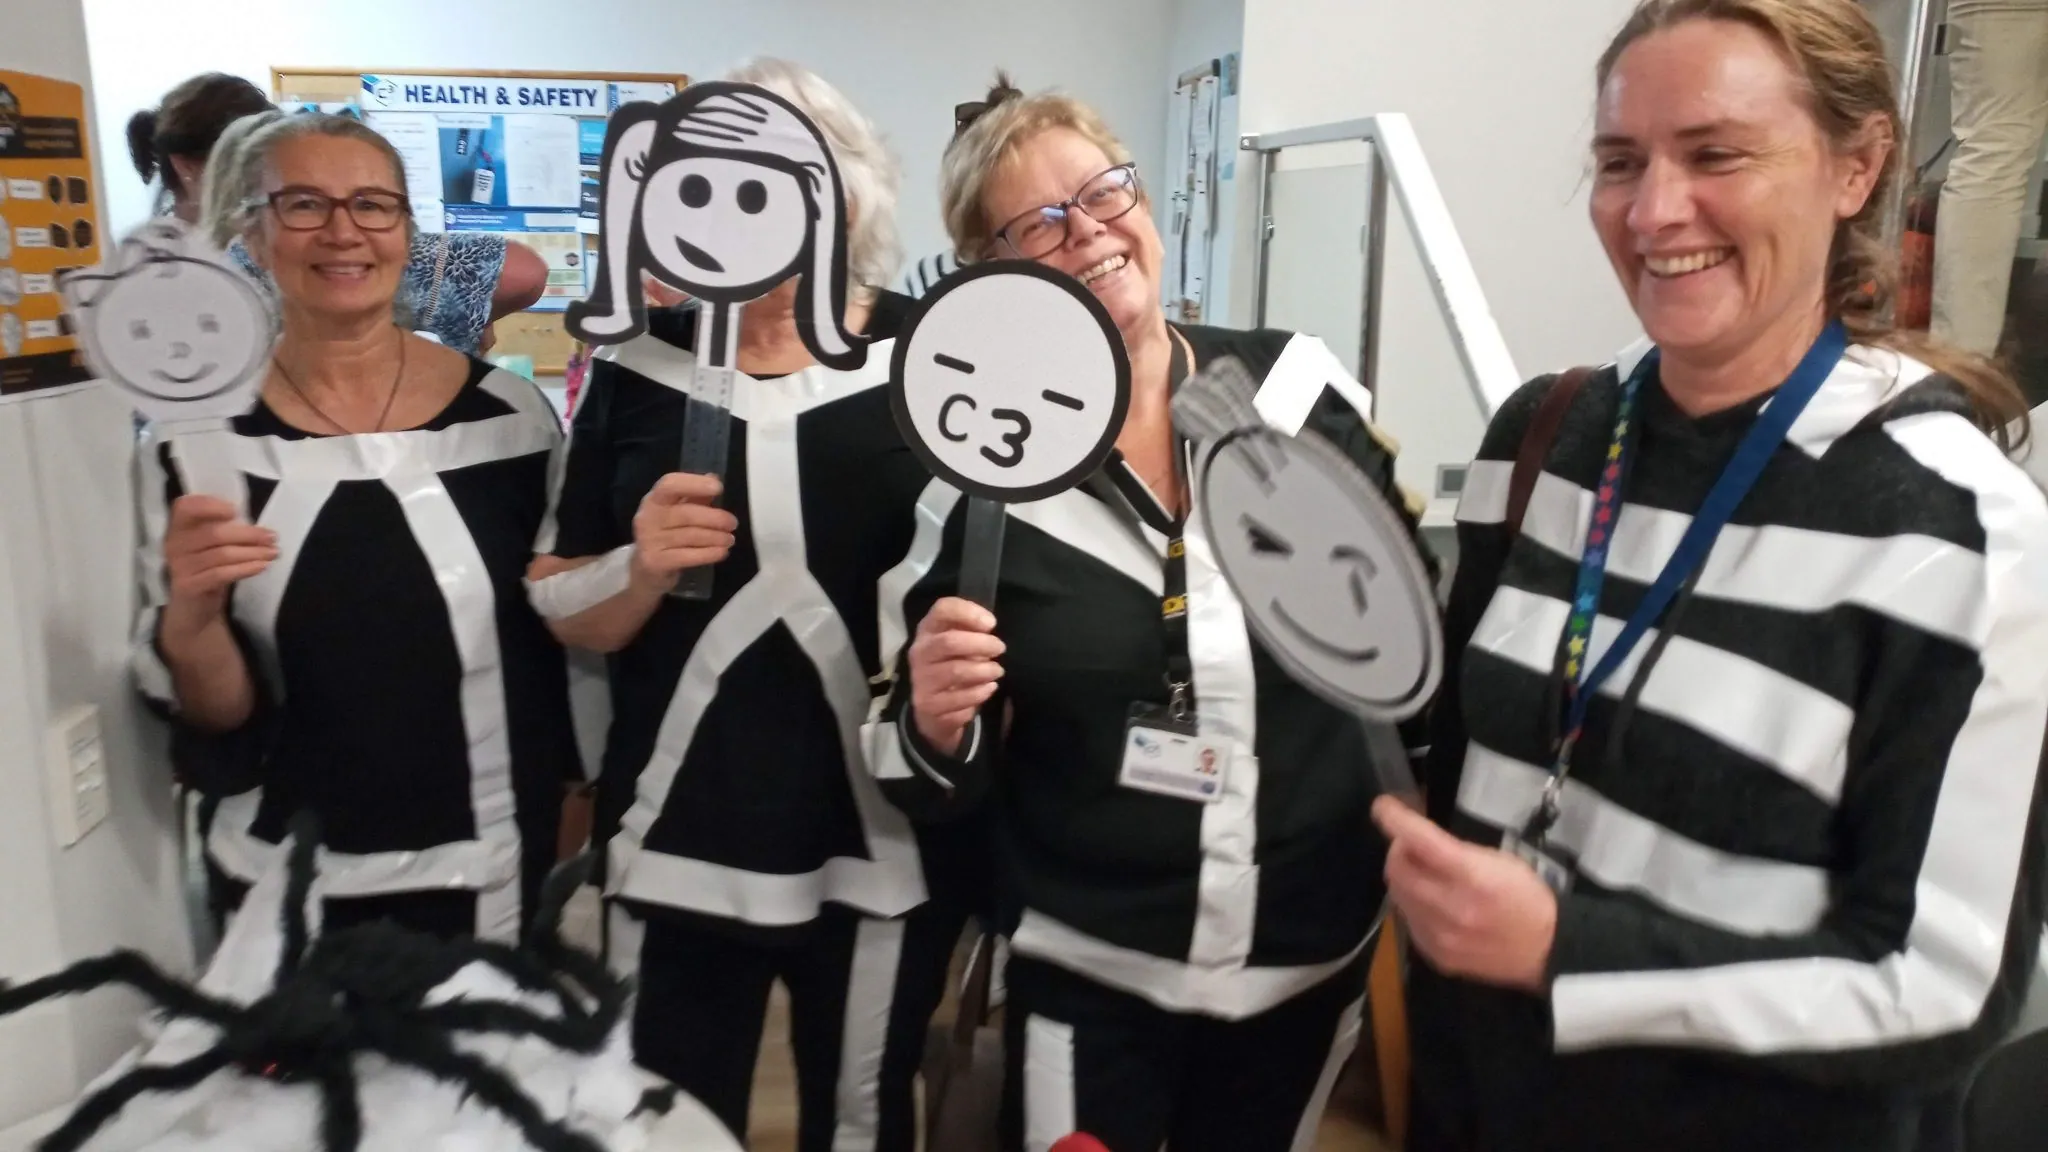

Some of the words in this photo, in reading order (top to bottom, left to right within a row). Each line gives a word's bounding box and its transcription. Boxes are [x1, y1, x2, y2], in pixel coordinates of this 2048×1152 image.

[404, 84, 487, 104] HEALTH
[495, 86, 512, 106] &
[517, 86, 598, 107] SAFETY
